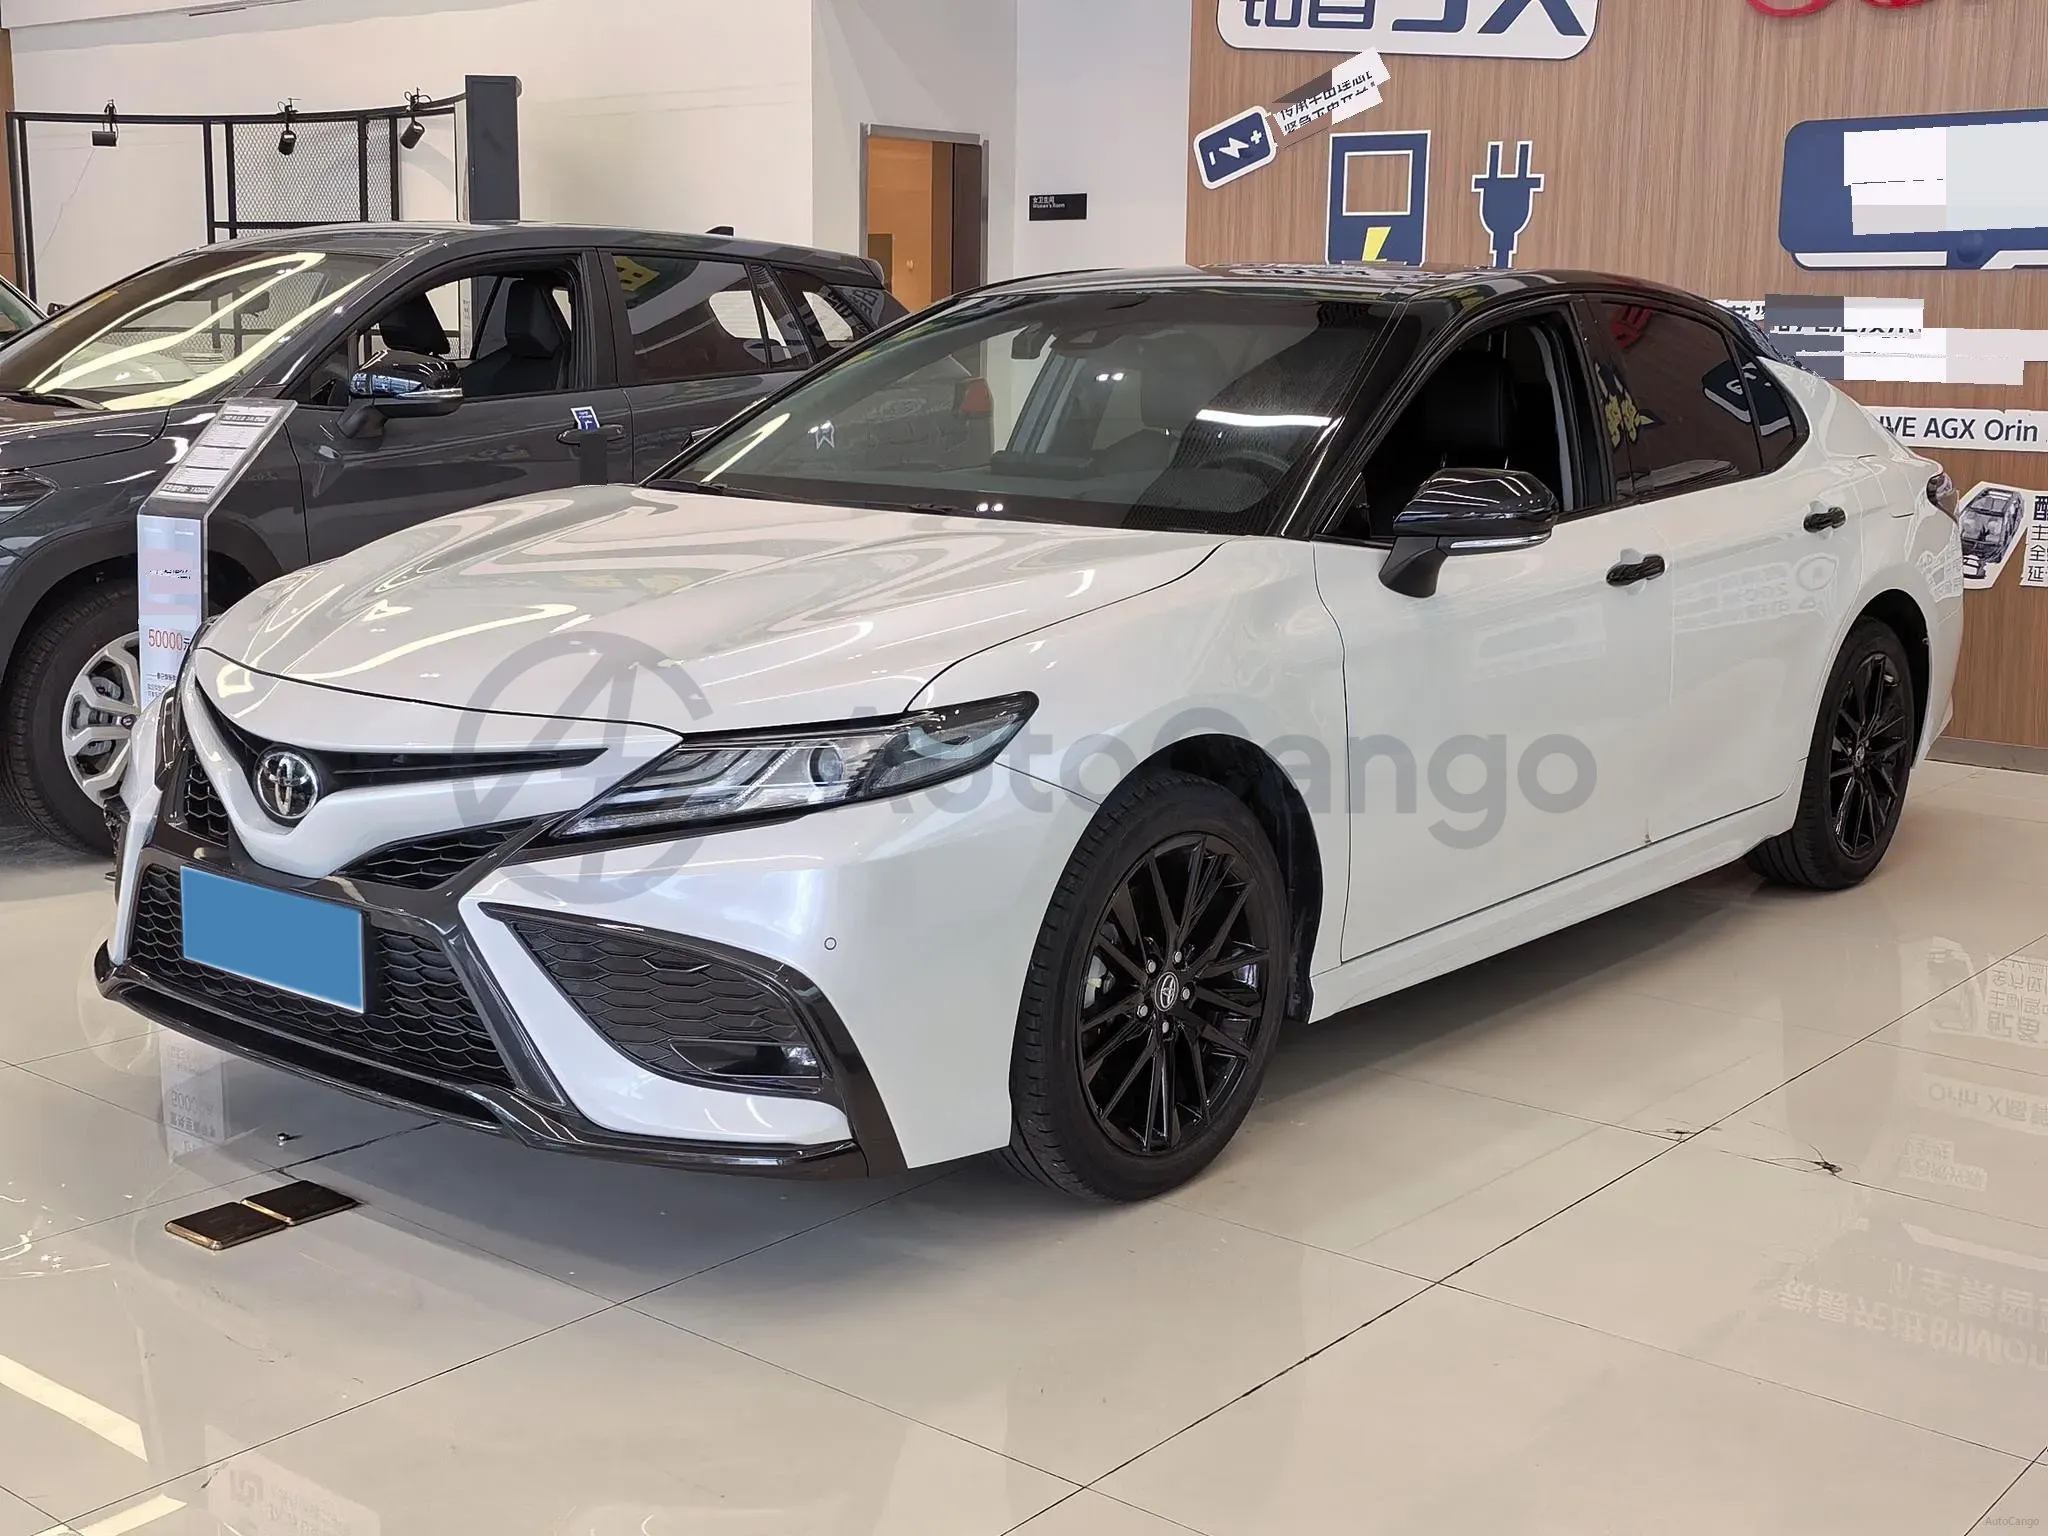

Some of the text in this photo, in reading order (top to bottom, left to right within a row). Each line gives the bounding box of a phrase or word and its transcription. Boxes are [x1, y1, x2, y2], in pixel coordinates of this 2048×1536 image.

[1923, 417, 1976, 440] AGX
[1984, 419, 2038, 442] Orin
[2029, 544, 2048, 562] 全
[2027, 565, 2048, 582] 延
